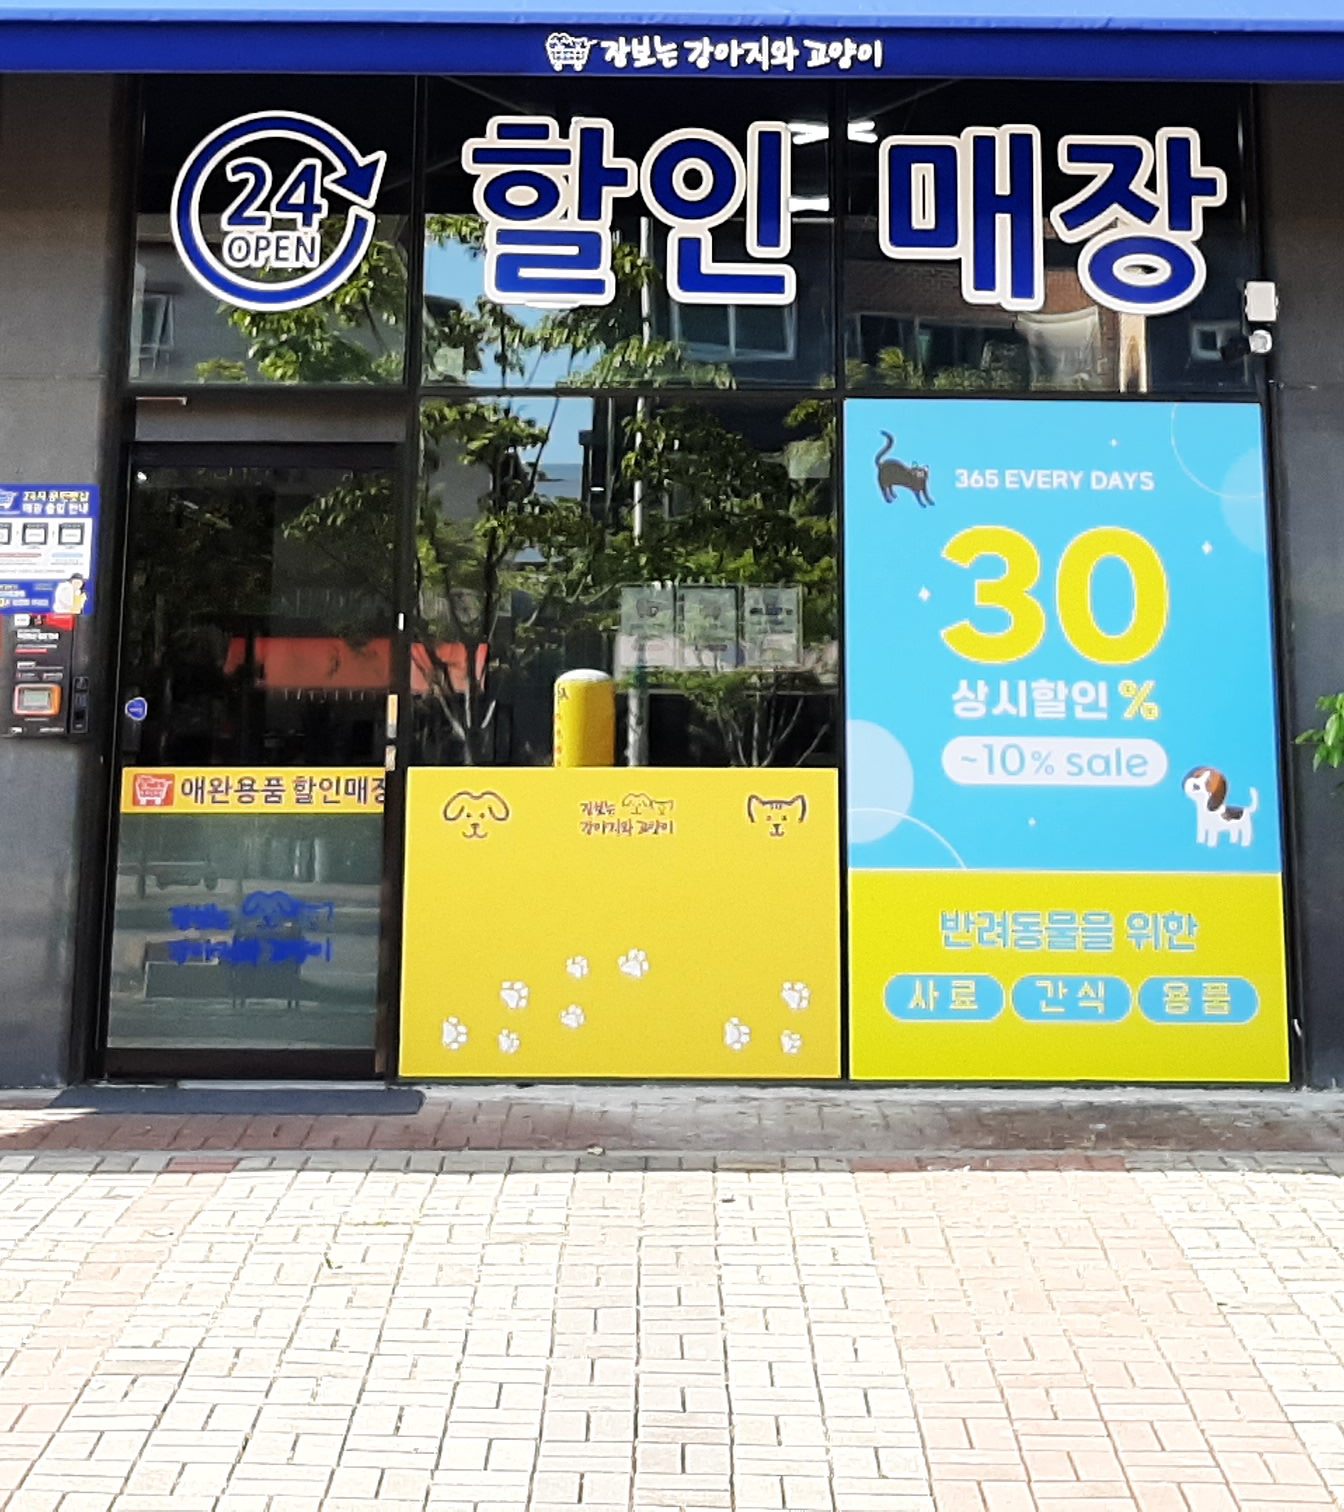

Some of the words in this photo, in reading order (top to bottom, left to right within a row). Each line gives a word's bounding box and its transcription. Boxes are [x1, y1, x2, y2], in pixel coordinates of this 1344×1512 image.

[600, 35, 678, 68] 장보는
[684, 35, 799, 71] 강아지와
[803, 38, 883, 70] 고양이
[220, 156, 328, 232] 24
[462, 116, 797, 308] 할인
[879, 124, 1227, 316] 매장
[223, 231, 321, 268] OPEN
[956, 469, 999, 489] 365
[1006, 470, 1083, 490] EVERY
[1091, 471, 1155, 491] DAYS
[941, 524, 1169, 665] 30
[953, 679, 1109, 719] 상시할인
[1066, 747, 1149, 778] sale
[181, 776, 286, 805] 애완용품
[940, 910, 1115, 952] 반려동물을
[1126, 911, 1200, 952] 위한
